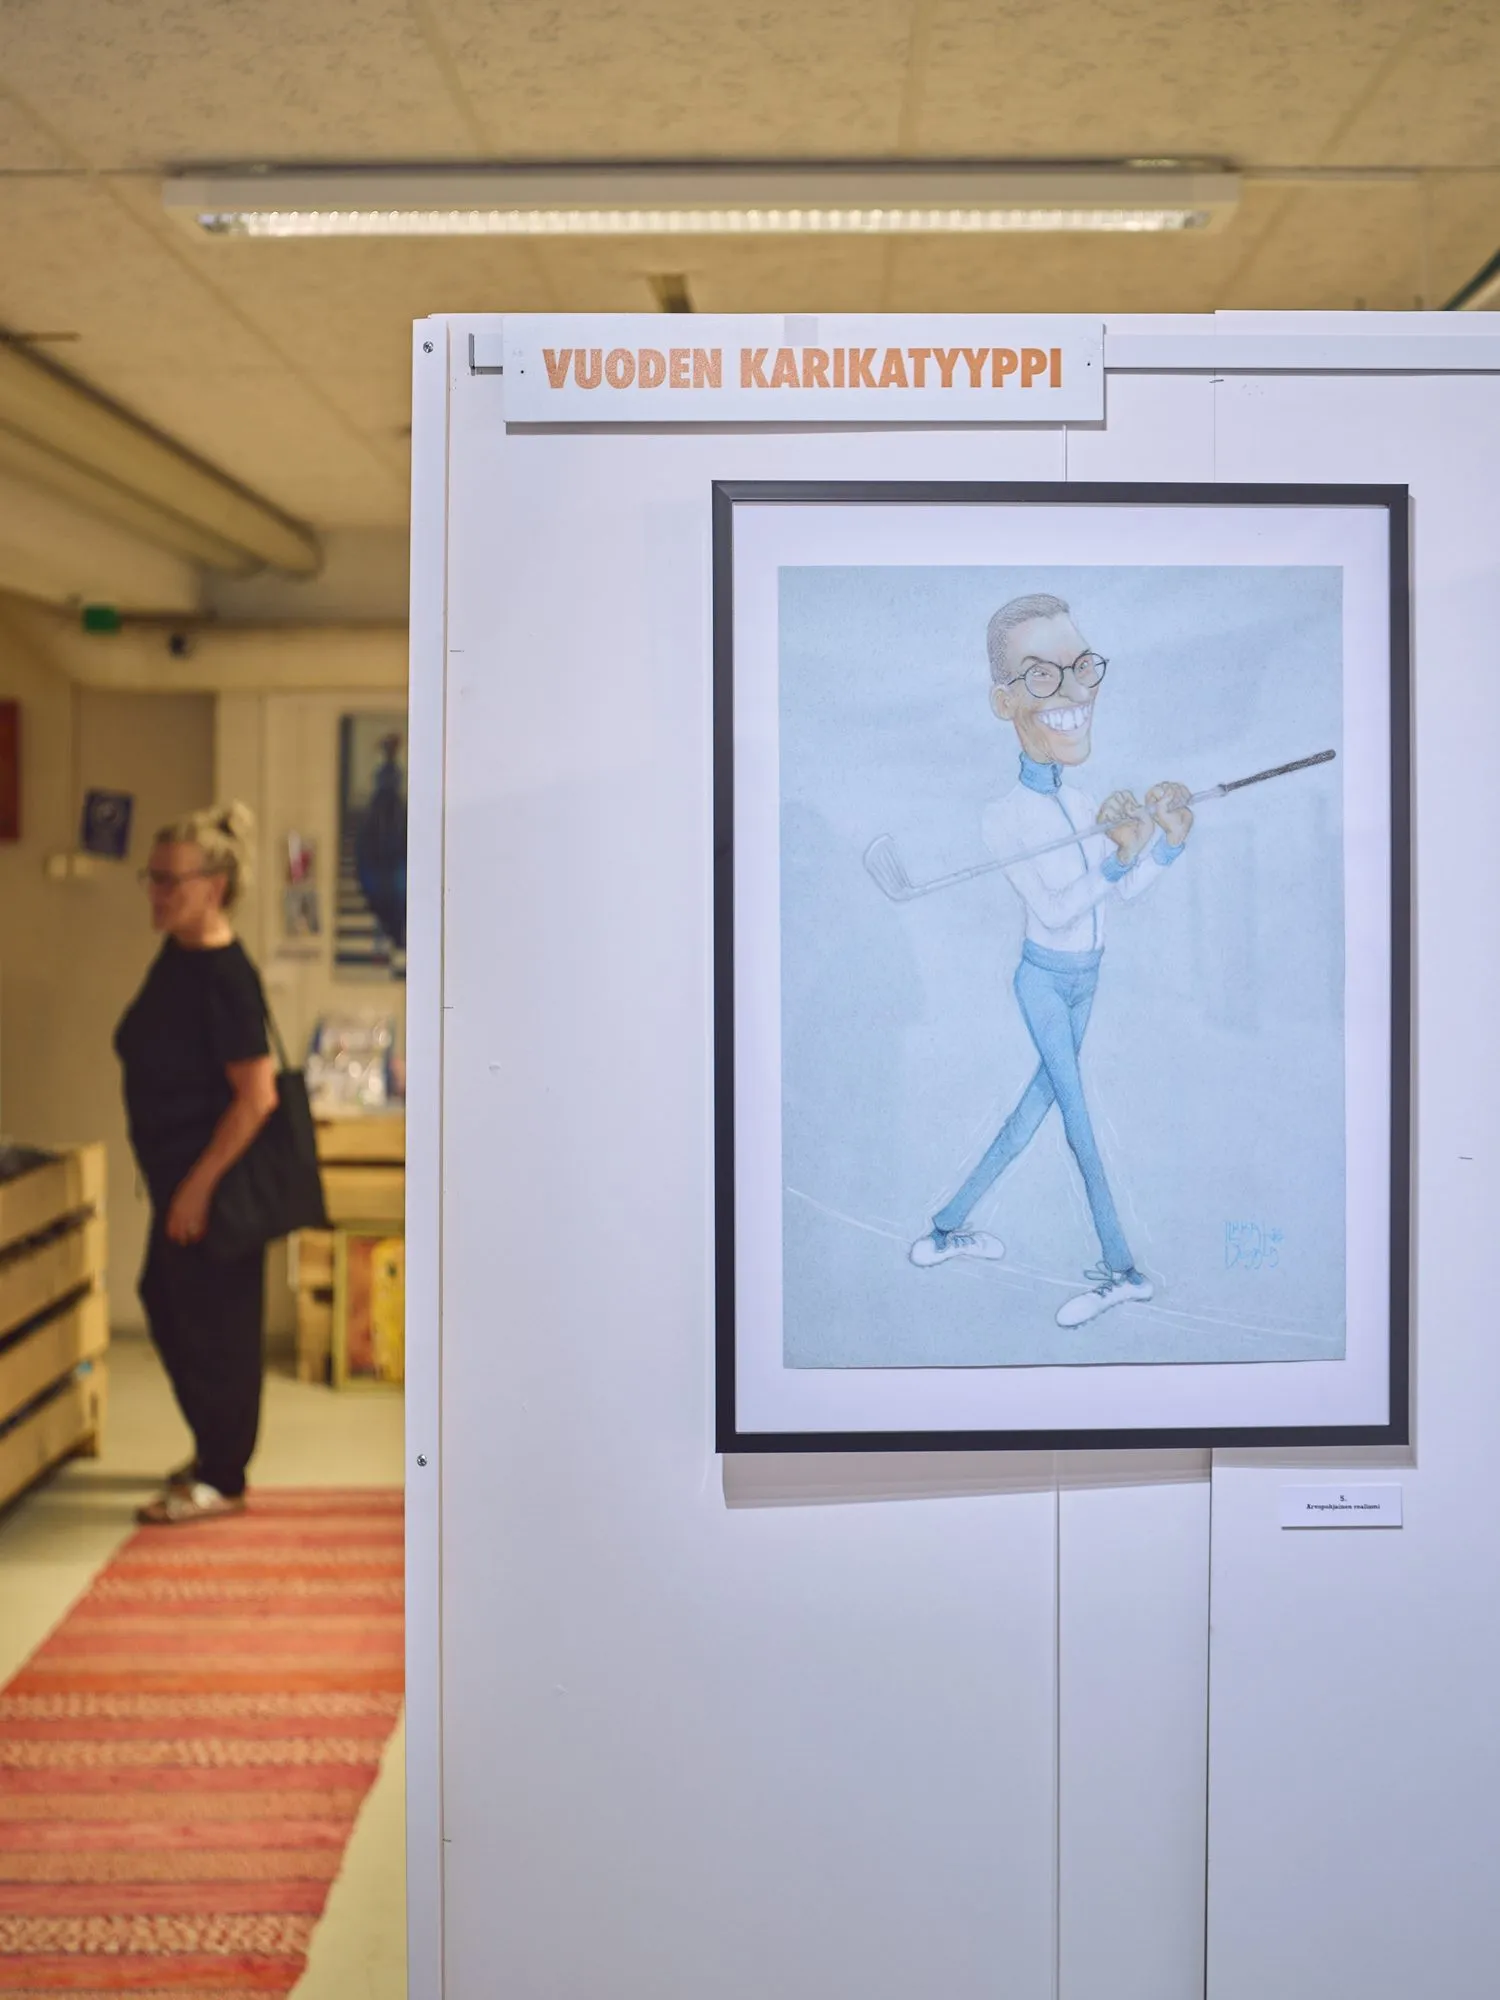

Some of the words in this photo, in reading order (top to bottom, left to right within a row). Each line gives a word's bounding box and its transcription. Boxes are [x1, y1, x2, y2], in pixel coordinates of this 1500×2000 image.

[542, 347, 723, 389] VUODEN
[739, 347, 1063, 389] KARIKATYYPPI
[1306, 1503, 1352, 1511] Arvopohjainen
